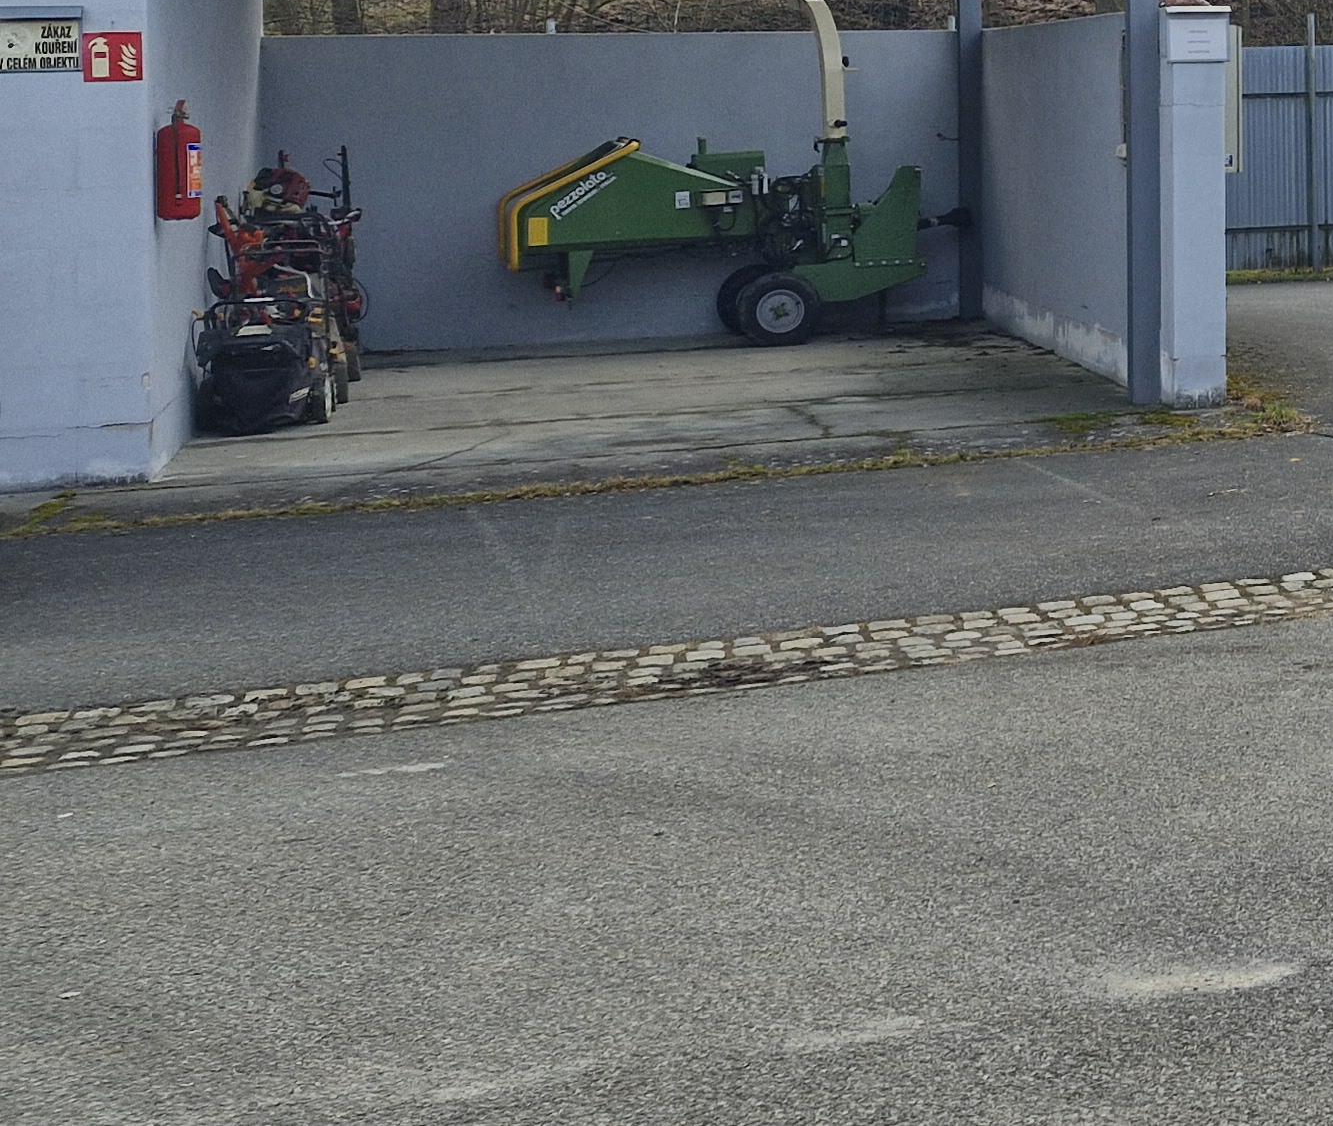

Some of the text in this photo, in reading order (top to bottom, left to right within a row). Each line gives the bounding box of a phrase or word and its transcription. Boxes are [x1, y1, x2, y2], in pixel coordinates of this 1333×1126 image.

[41, 23, 72, 39] ZÁKAZ
[35, 37, 78, 54] KOUŘENÍ
[7, 54, 37, 70] CELÉM
[40, 56, 79, 70] OBJEKTU
[550, 171, 607, 220] pezzolato
